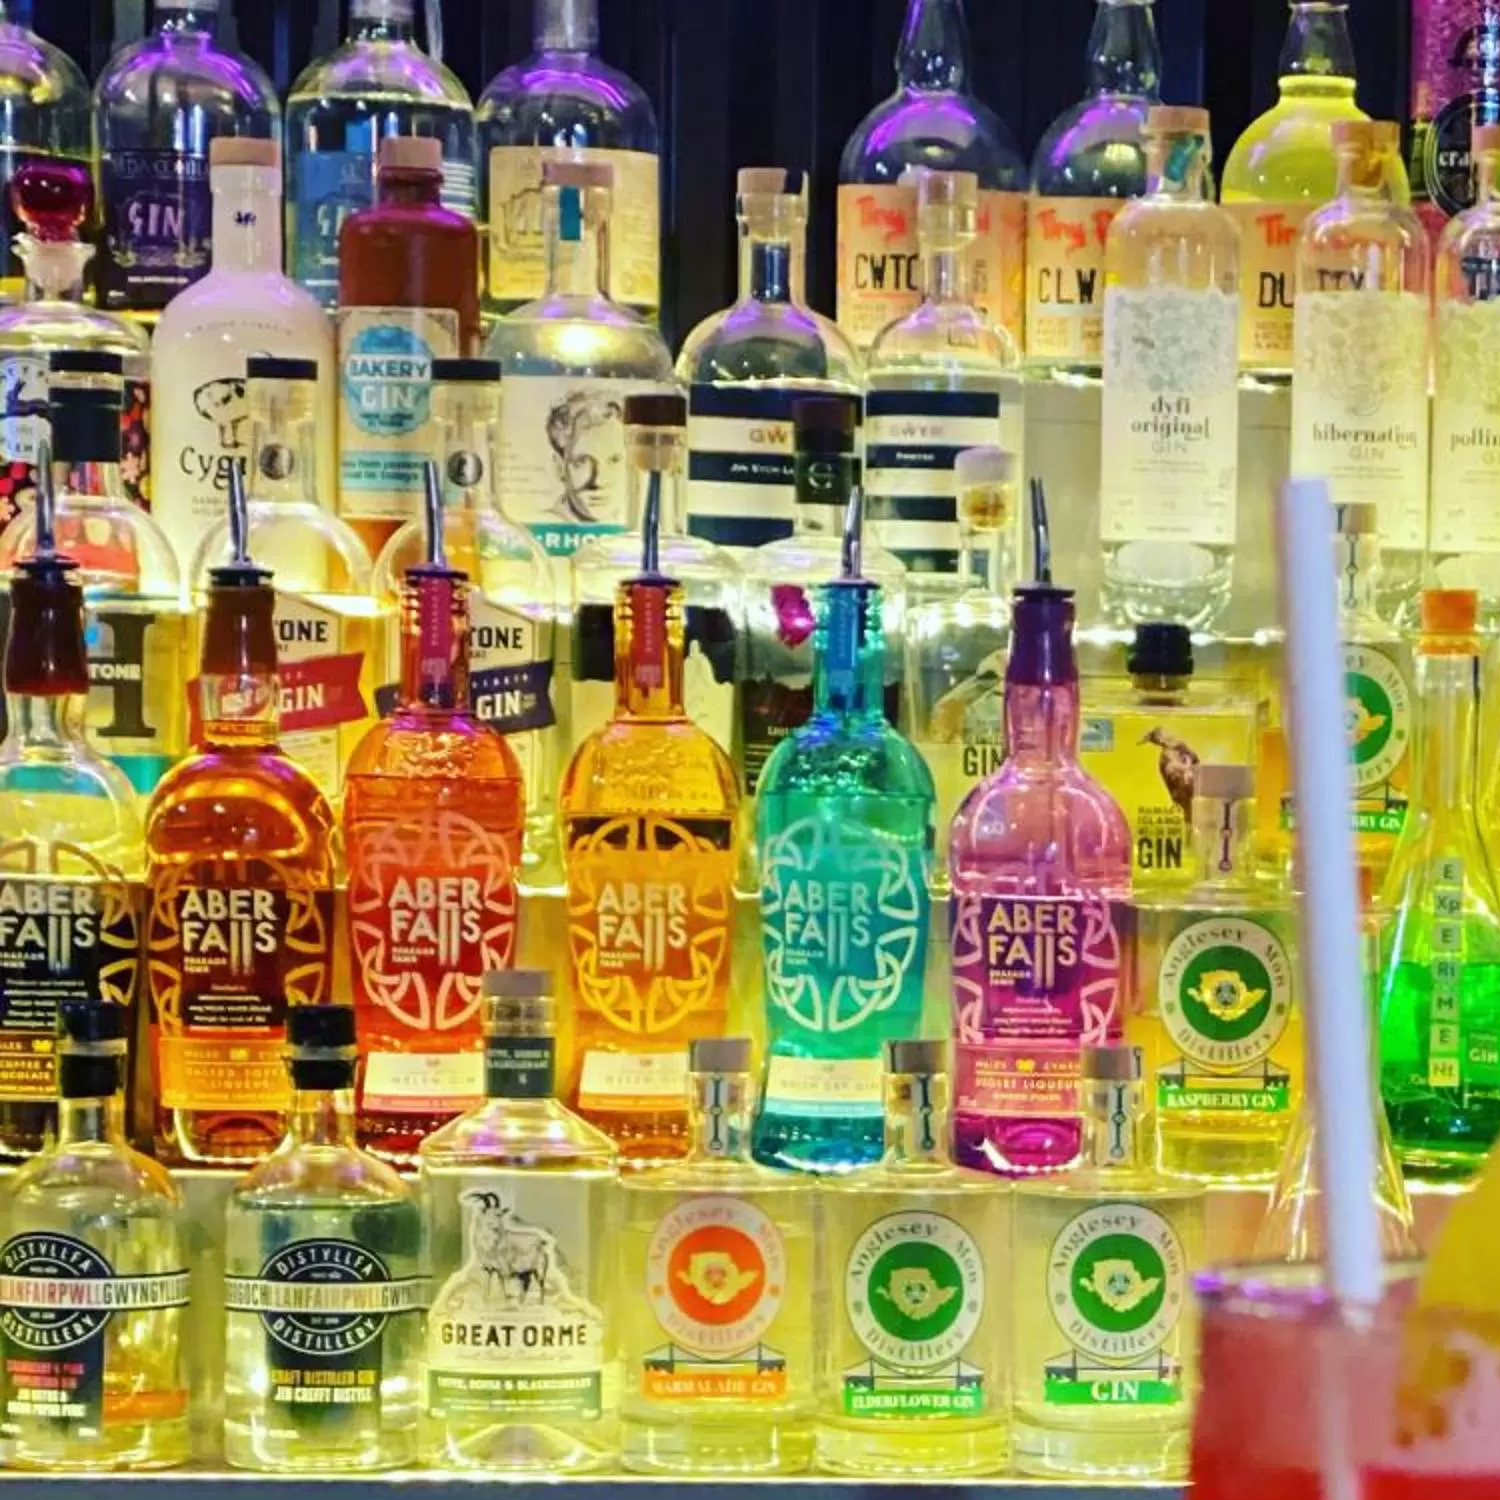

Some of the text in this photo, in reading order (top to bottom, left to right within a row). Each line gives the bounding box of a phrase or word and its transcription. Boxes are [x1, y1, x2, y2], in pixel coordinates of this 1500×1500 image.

[128, 202, 184, 237] GIN
[1039, 267, 1097, 305] CLW
[350, 359, 428, 378] BAKERY
[1151, 396, 1191, 419] dyfi
[1130, 416, 1210, 443] original
[1151, 438, 1189, 454] GIN
[1347, 445, 1386, 462] GIN
[279, 683, 325, 713] GIN
[475, 689, 522, 720] GIN
[1137, 837, 1183, 869] GIN
[181, 888, 279, 921] ABER
[387, 875, 484, 910] ABER
[597, 882, 689, 915] ABER
[783, 880, 872, 916] ABER
[986, 903, 1079, 934] ABER
[1167, 1092, 1278, 1108] RASPBERRY GIN
[4, 1242, 93, 1272] DISTYLLFA
[276, 1248, 373, 1277] DISTYLLFA
[3, 1311, 95, 1345] DISTILLERY
[271, 1317, 377, 1350] DISTILLERY
[441, 1323, 588, 1347] GREAT ORME
[852, 1395, 950, 1409] ELDERFLOWER
[1090, 1380, 1141, 1401] GIN
